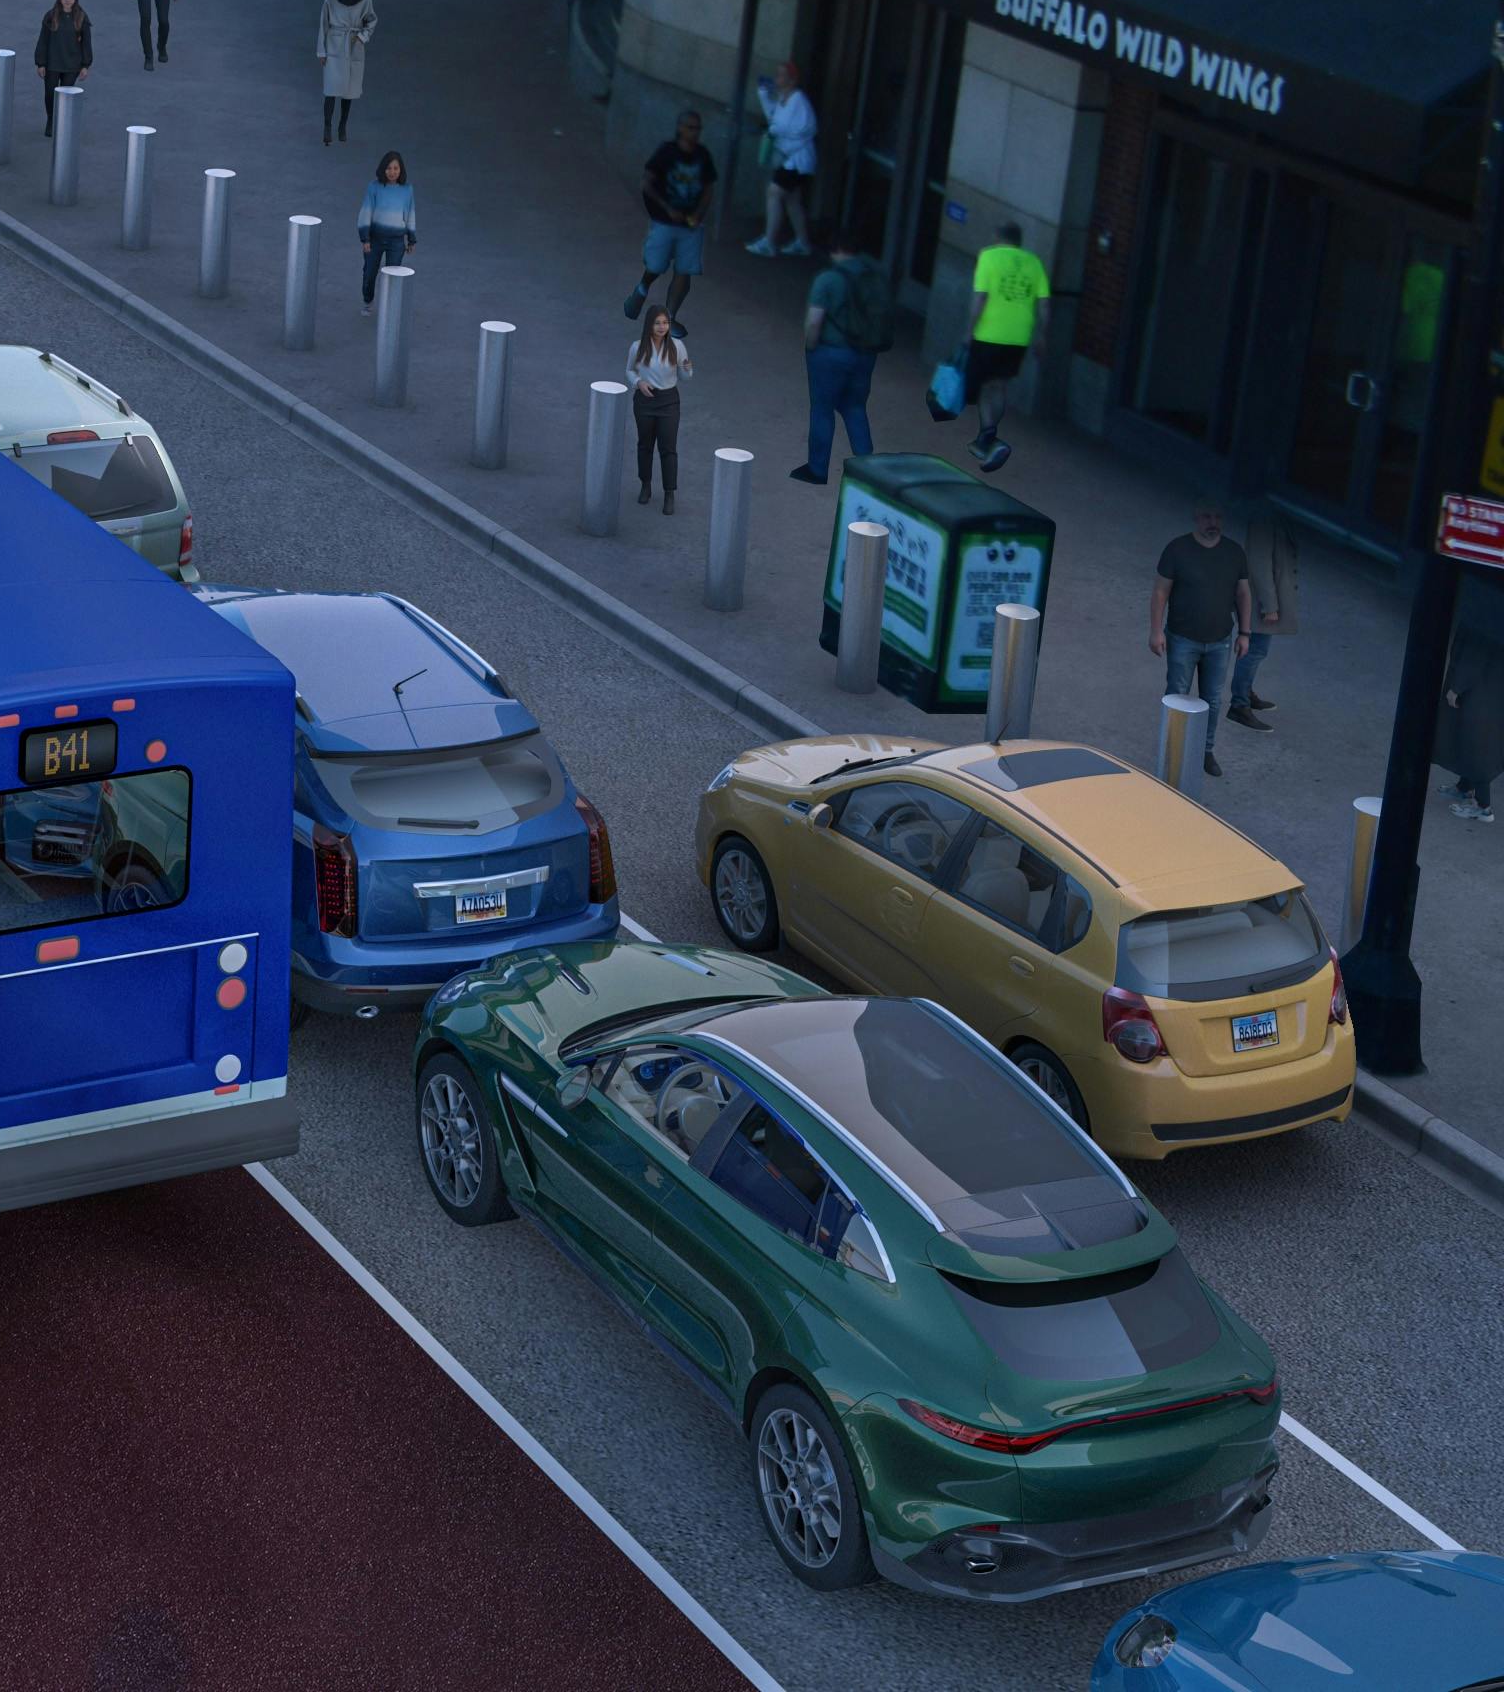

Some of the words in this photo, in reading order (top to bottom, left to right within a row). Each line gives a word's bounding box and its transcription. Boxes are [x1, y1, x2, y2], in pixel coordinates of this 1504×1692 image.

[1115, 16, 1185, 78] WILD
[1191, 44, 1285, 115] WINGS
[1450, 502, 1467, 514] NO
[42, 729, 92, 776] B41
